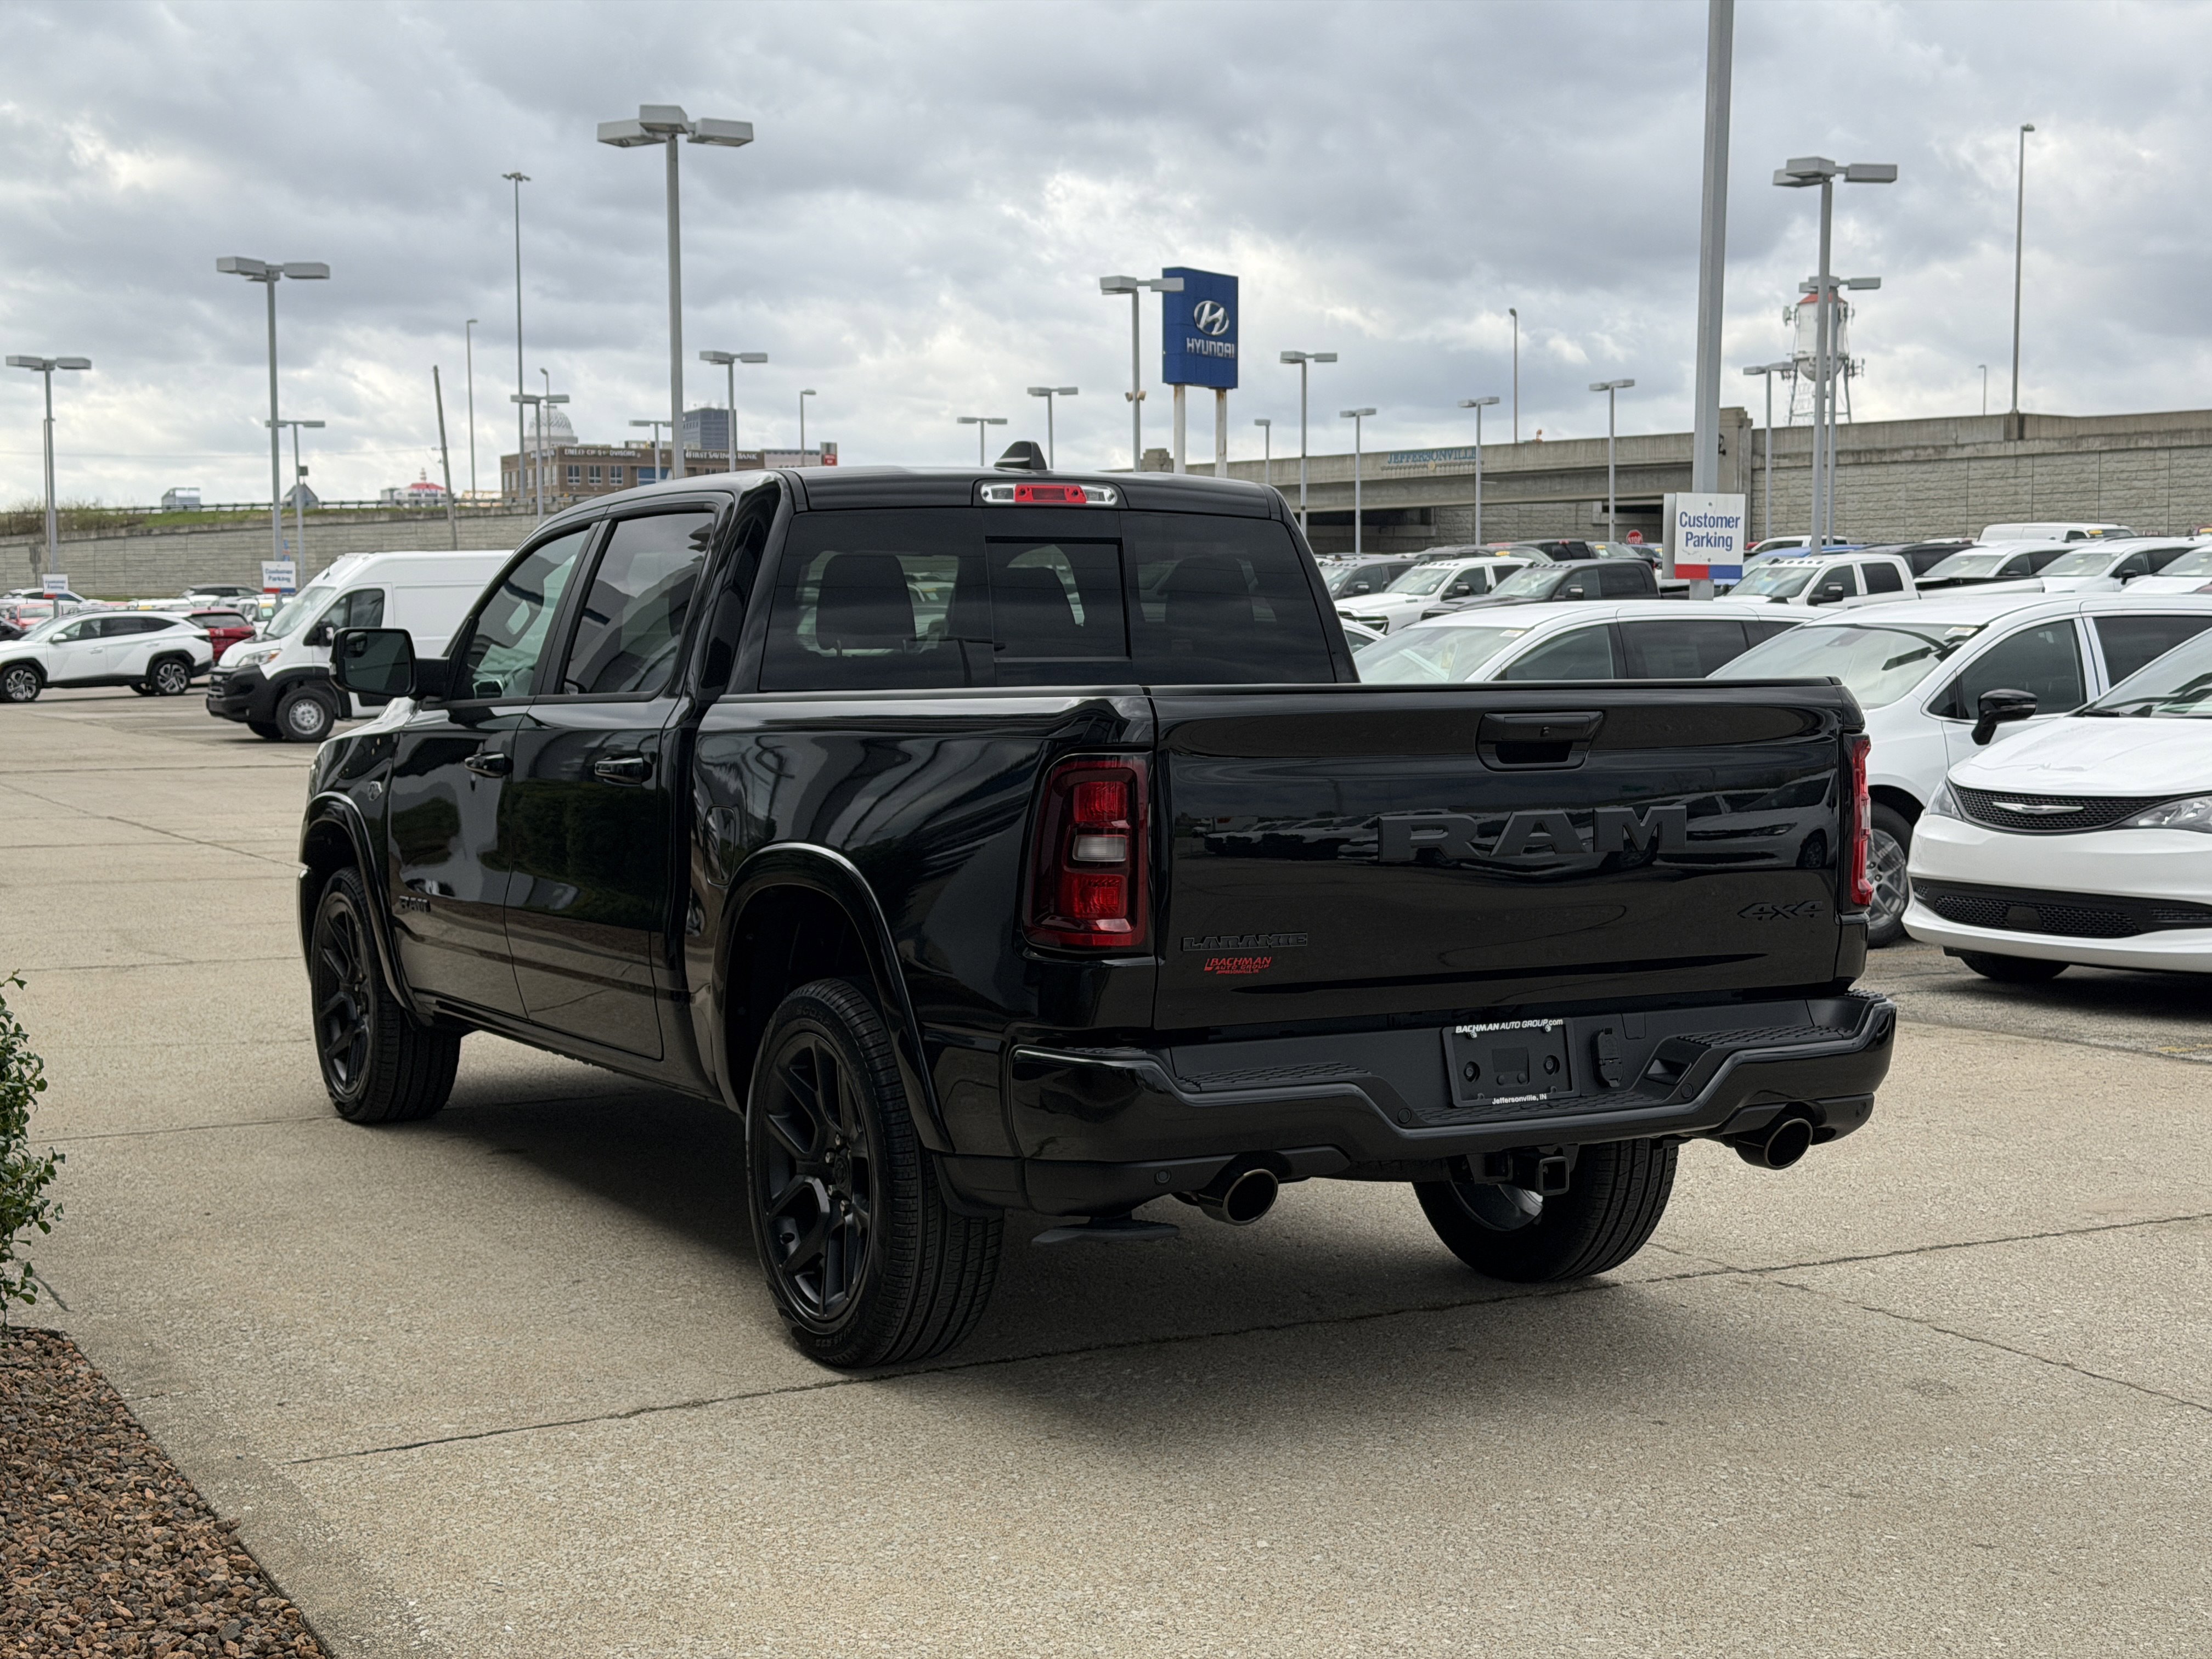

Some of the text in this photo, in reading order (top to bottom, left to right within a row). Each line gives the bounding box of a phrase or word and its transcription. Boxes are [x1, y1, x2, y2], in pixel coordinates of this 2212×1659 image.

[1186, 337, 1234, 358] HYUNDAI
[1679, 511, 1740, 529] Customer
[1628, 535, 1641, 544] STOP
[1685, 531, 1733, 551] Parking
[1378, 805, 1687, 862] RAM
[1183, 933, 1308, 951] LARAMIE
[1209, 957, 1272, 966] BACHMAN
[1455, 1019, 1563, 1034] BACHMAN AUTO GROUPcom
[1492, 1094, 1538, 1104] Jeffersonville,
